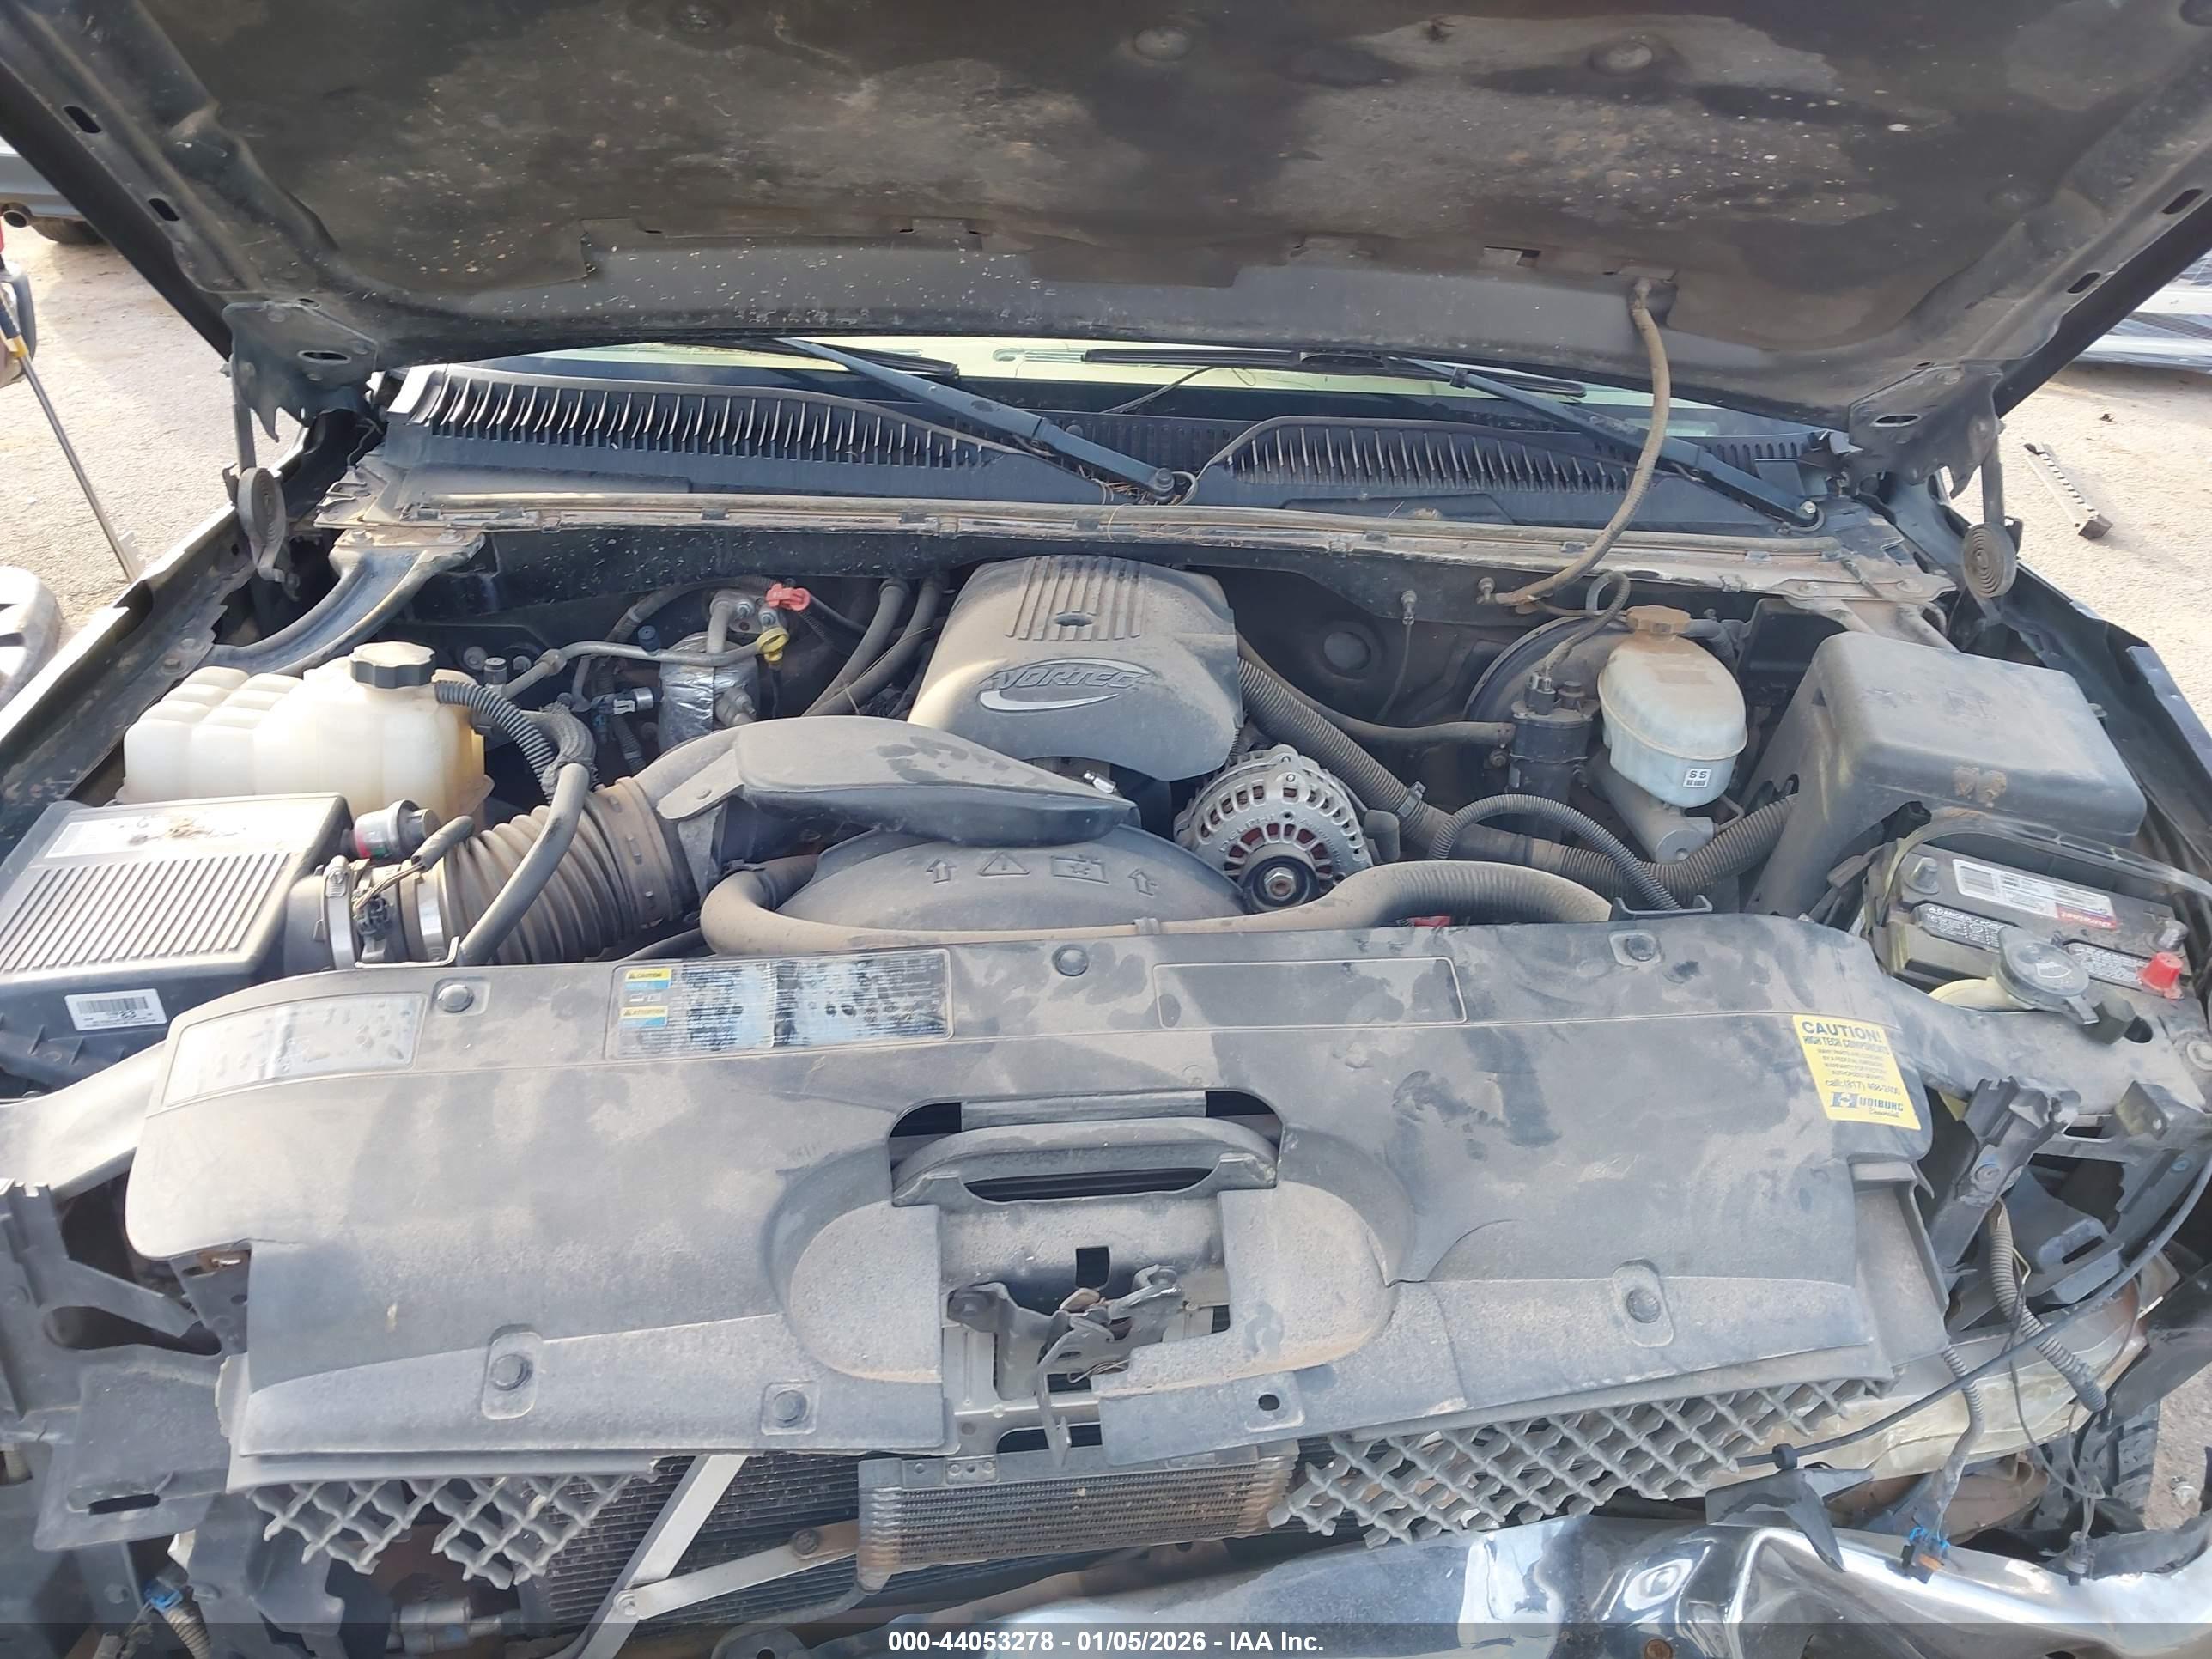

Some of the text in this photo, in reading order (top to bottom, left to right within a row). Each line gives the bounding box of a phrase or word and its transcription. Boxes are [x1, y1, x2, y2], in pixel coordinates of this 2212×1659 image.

[994, 666, 1142, 690] VORTEC
[1219, 814, 1275, 853] DELPHI
[1802, 1021, 1883, 1042] CAUTION!
